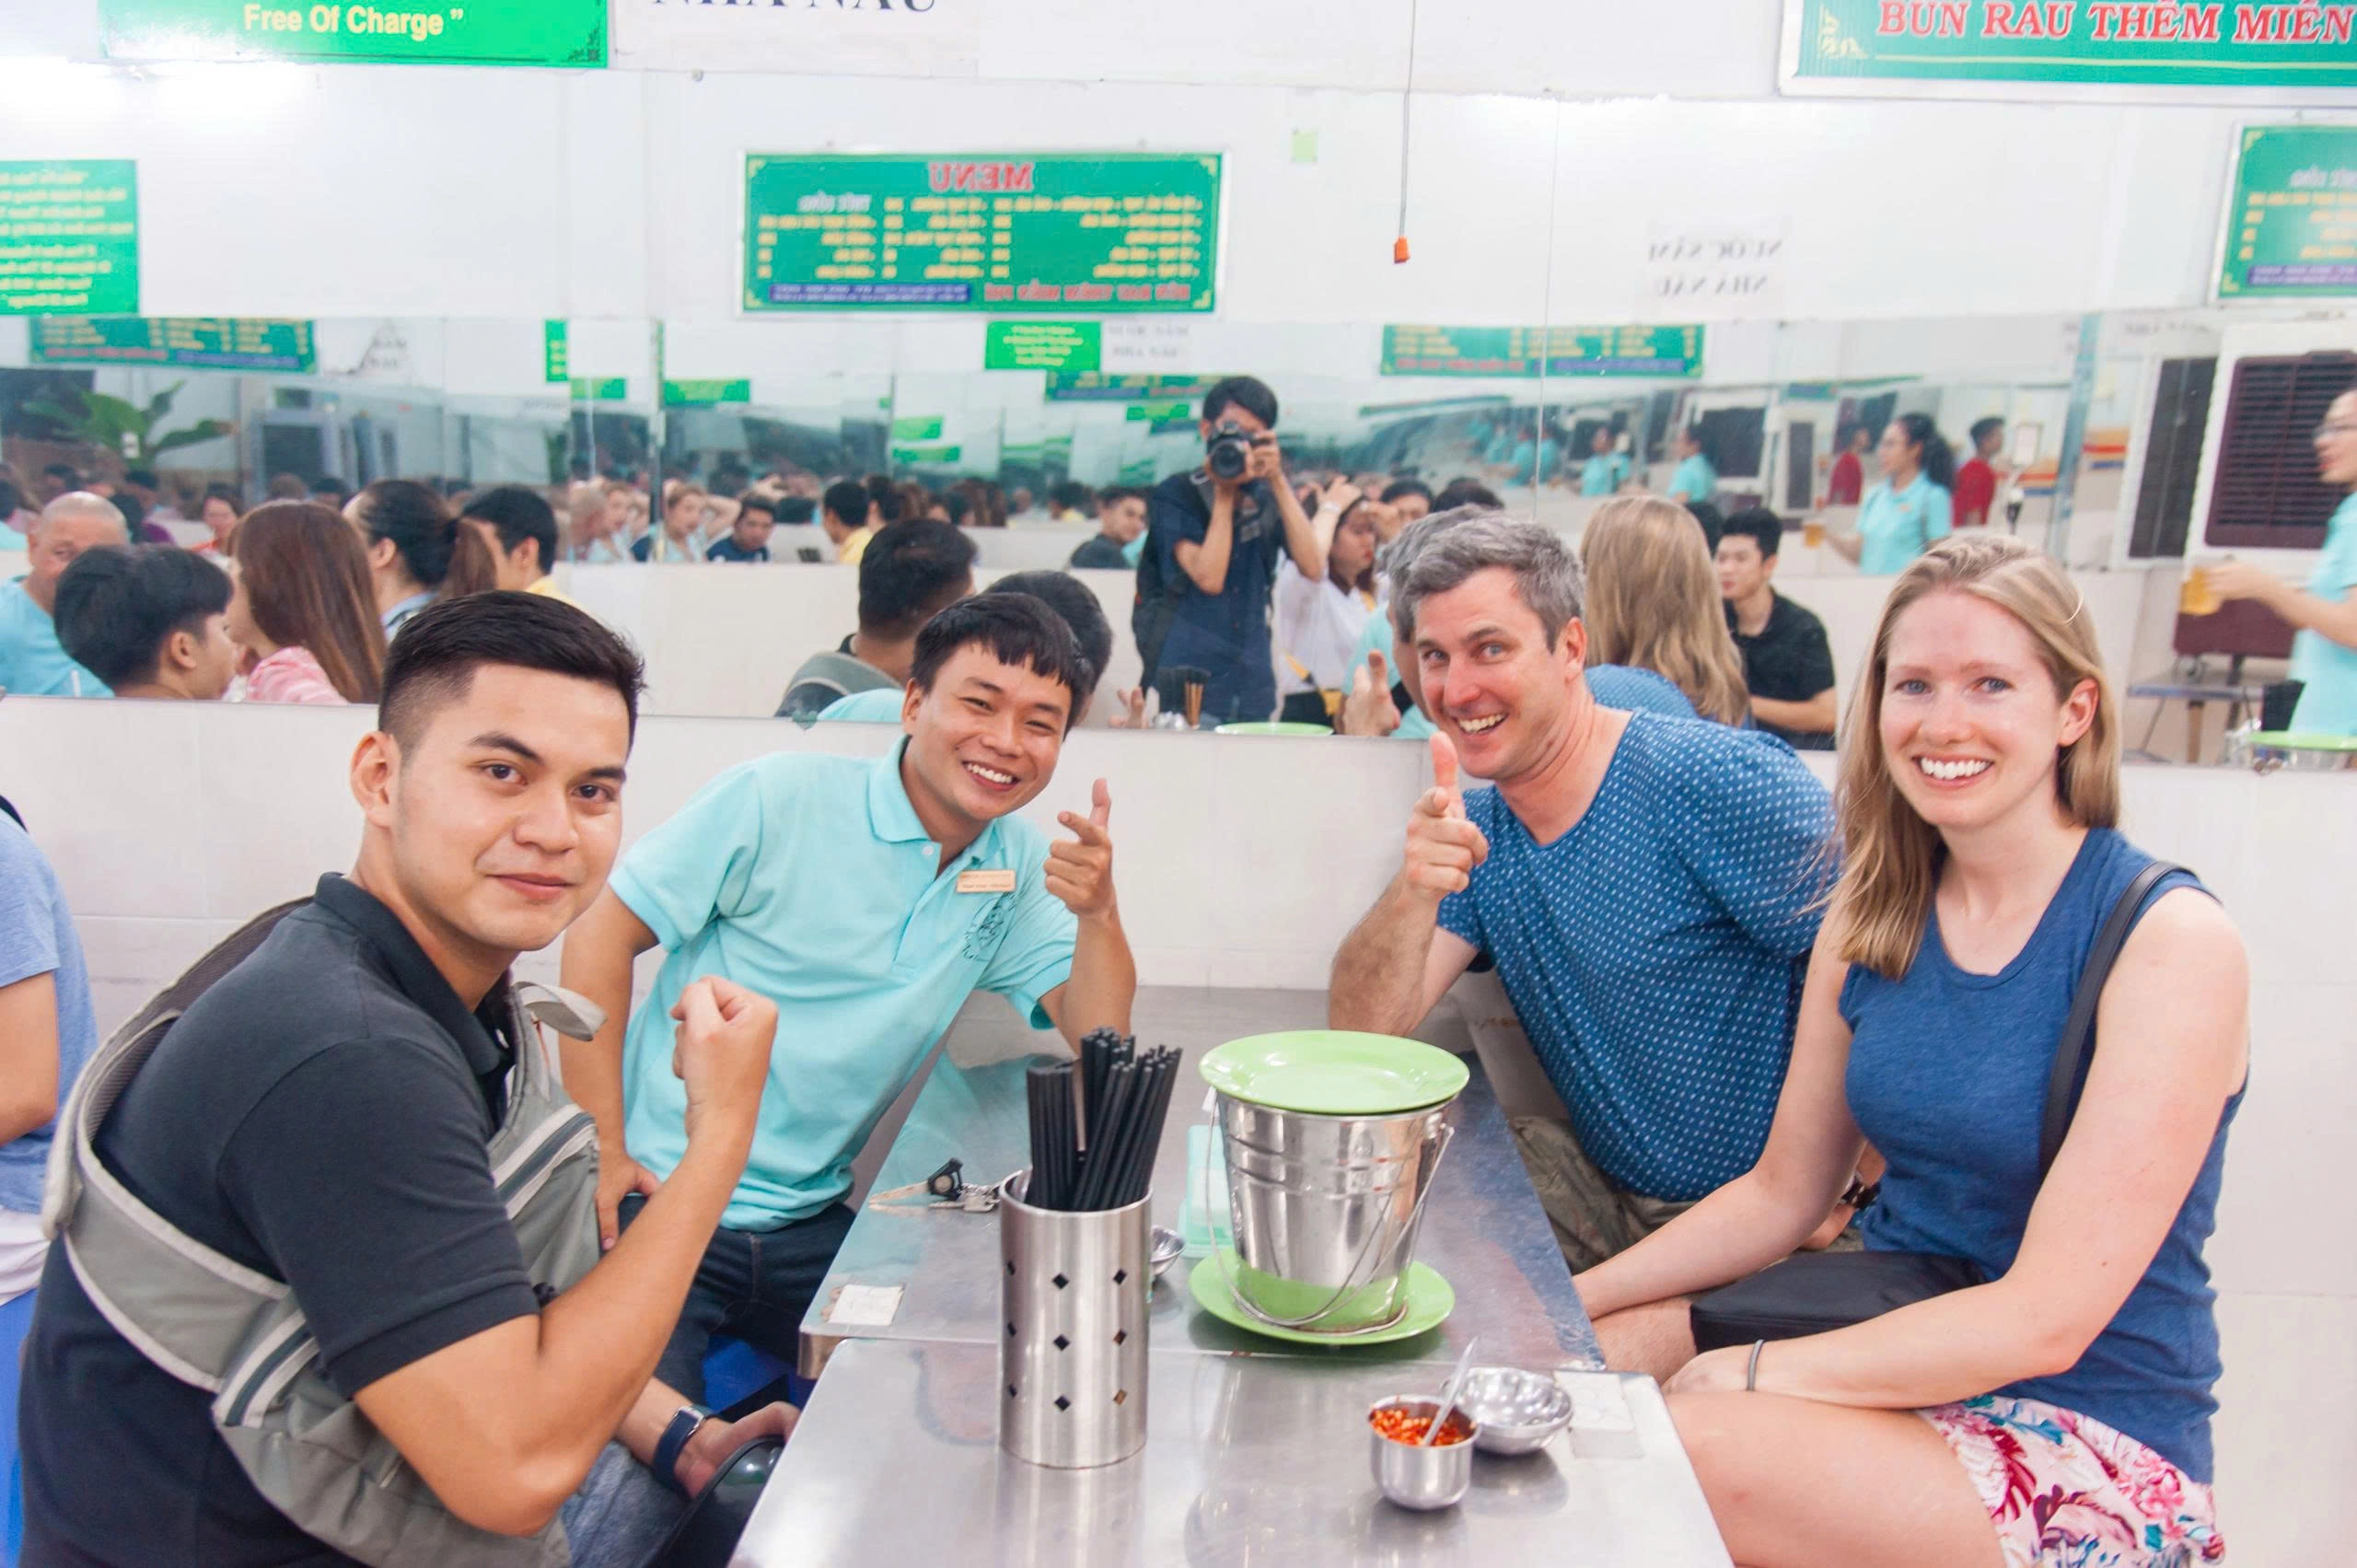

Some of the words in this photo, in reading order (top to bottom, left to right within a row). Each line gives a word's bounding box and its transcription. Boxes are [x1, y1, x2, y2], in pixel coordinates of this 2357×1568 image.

[244, 3, 302, 32] Free
[309, 4, 340, 33] Of
[346, 4, 444, 41] Charge
[1981, 0, 2076, 39] RAU
